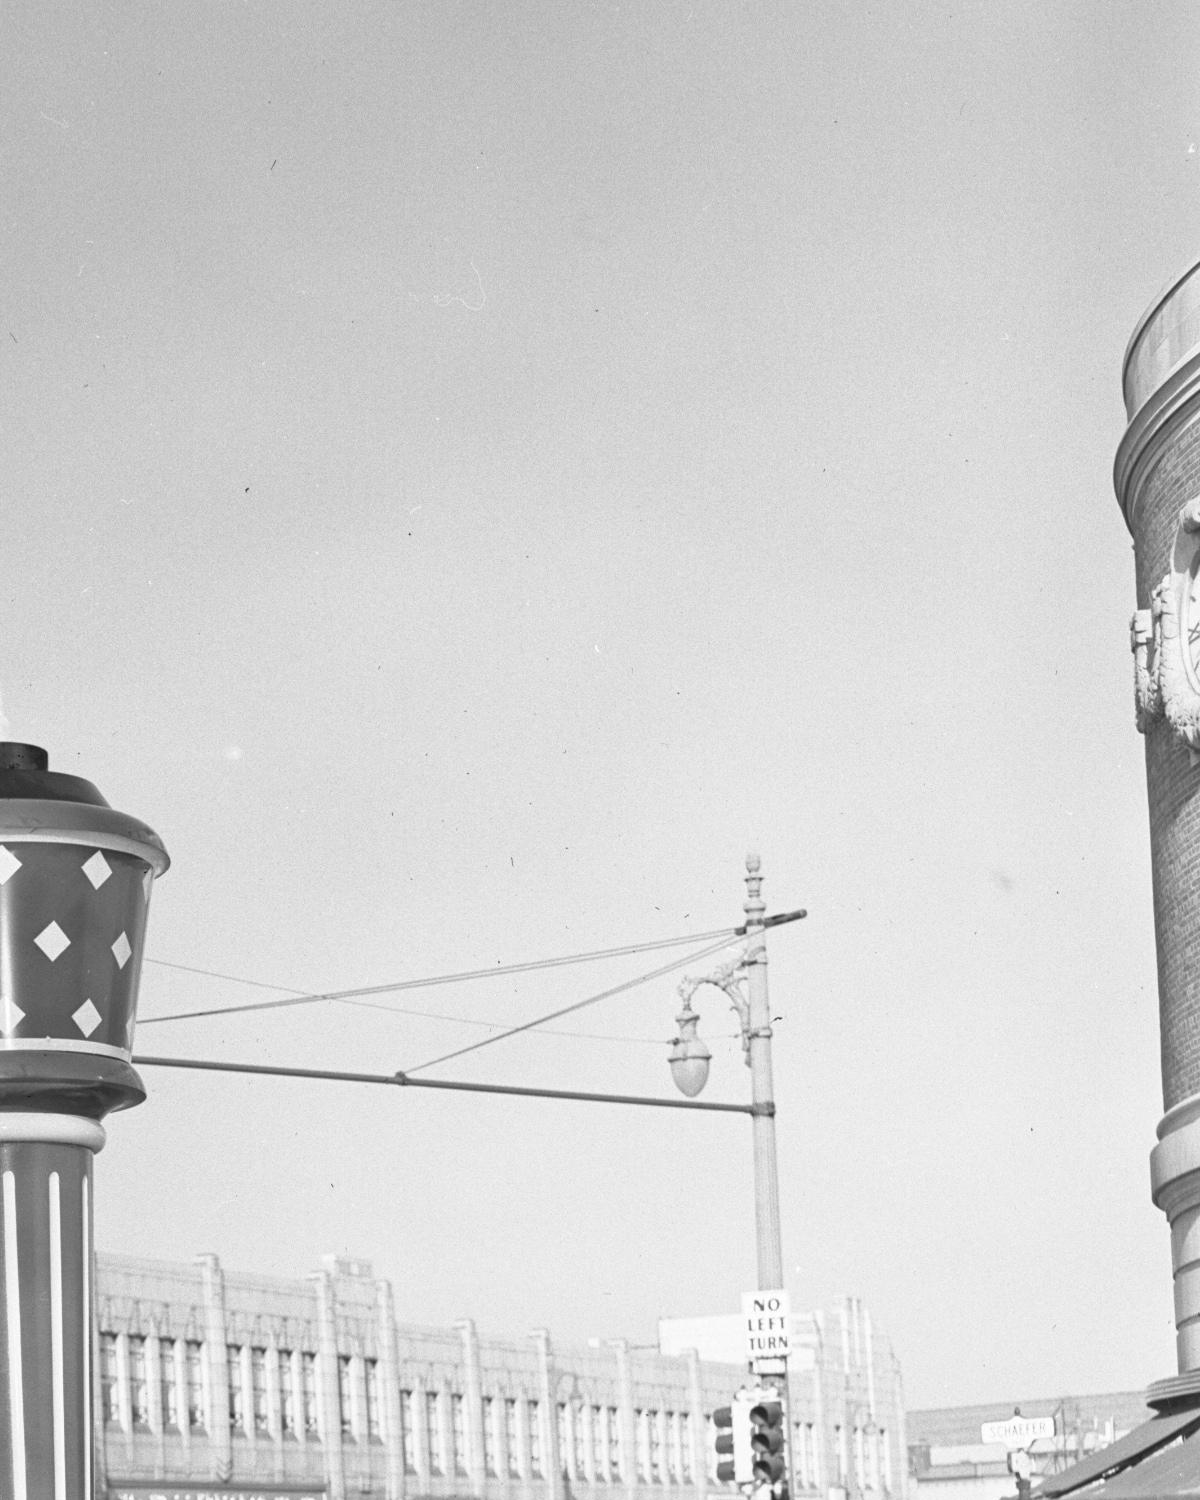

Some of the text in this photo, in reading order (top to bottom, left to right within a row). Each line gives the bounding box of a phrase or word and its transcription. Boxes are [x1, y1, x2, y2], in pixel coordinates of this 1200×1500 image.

[754, 1298, 780, 1312] NO
[748, 1316, 785, 1331] LEFT
[749, 1336, 788, 1350] TURN
[990, 1422, 1046, 1438] SCHAEFER
